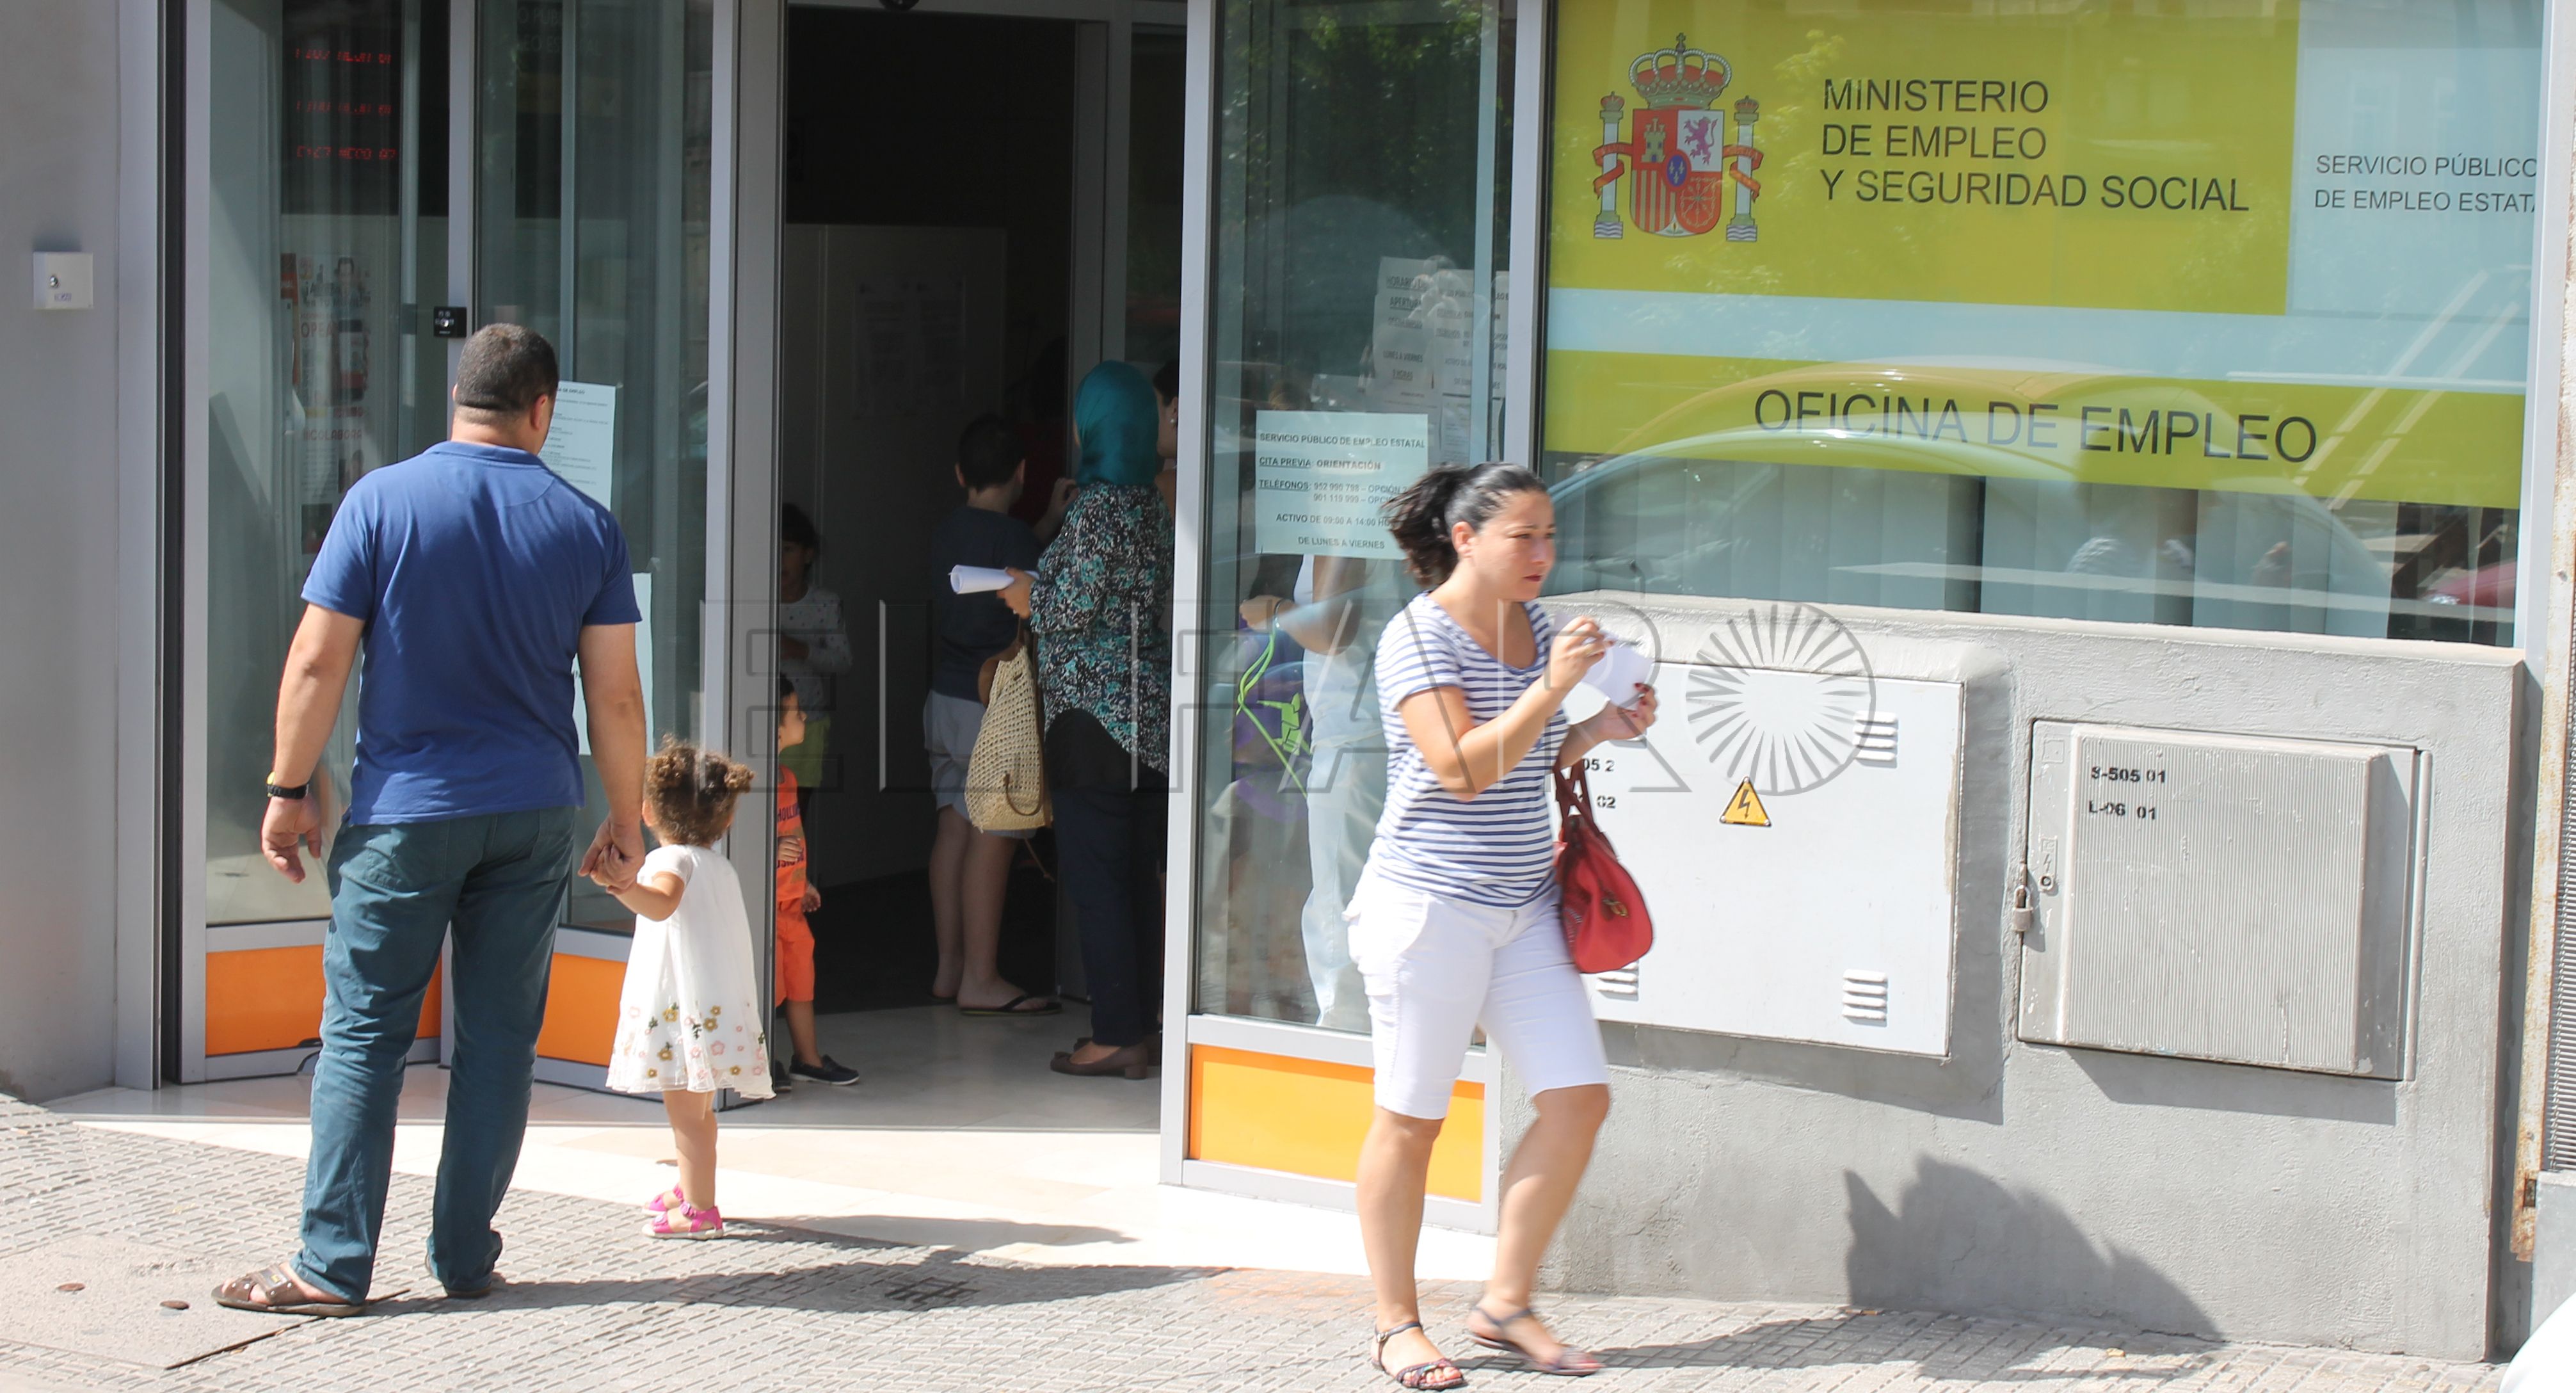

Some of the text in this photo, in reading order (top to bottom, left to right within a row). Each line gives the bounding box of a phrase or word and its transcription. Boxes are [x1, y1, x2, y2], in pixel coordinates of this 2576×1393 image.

[1823, 78, 2049, 113] MINISTERIO
[1822, 124, 2047, 159] DE EMPLEO
[2316, 152, 2537, 178] SERVICIO PÚBLICO
[1820, 169, 2250, 212] Y SEGURIDAD SOCIAL
[2314, 189, 2536, 213] DE EMPLEO ESTAT
[1754, 388, 2317, 463] OFICINA DE EMPLEO
[1260, 432, 1426, 449] SERVICIO PÚBLICO DE EMPLEO ESTATAL
[1259, 456, 1279, 467] CITA
[1316, 458, 1382, 471] ORIENTACIÓN
[1276, 513, 1308, 524] ACTIVO
[1309, 514, 1321, 524] DE
[1346, 517, 1352, 525] A
[1356, 517, 1376, 527] 14:00
[1298, 536, 1385, 549] DE LUNES A VIERNES
[2091, 766, 2166, 784] S-505 01
[2136, 805, 2156, 821] 01
